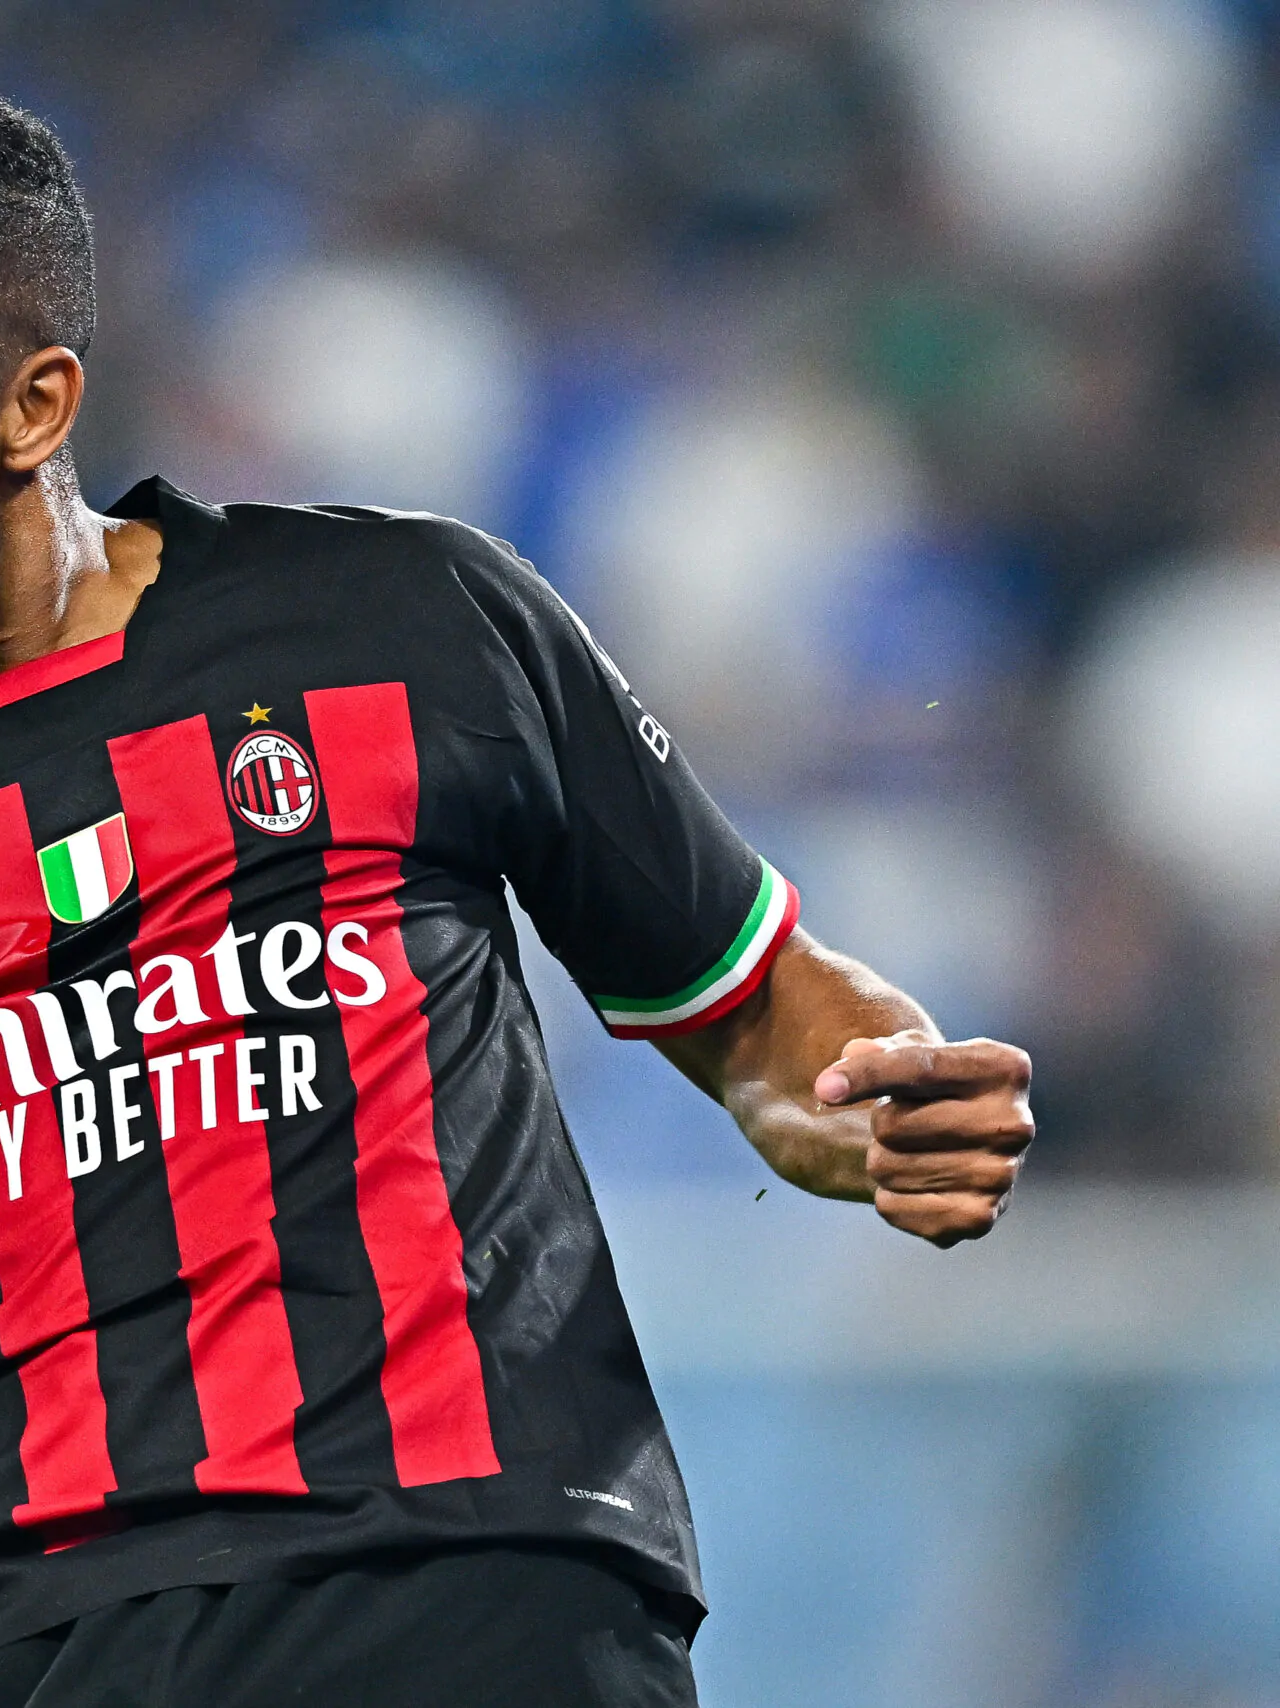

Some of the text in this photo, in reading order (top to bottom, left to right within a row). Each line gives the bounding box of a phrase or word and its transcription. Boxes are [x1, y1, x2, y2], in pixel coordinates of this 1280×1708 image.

[243, 740, 291, 762] ACM
[259, 813, 301, 825] 1899
[60, 1034, 324, 1179] BETTER
